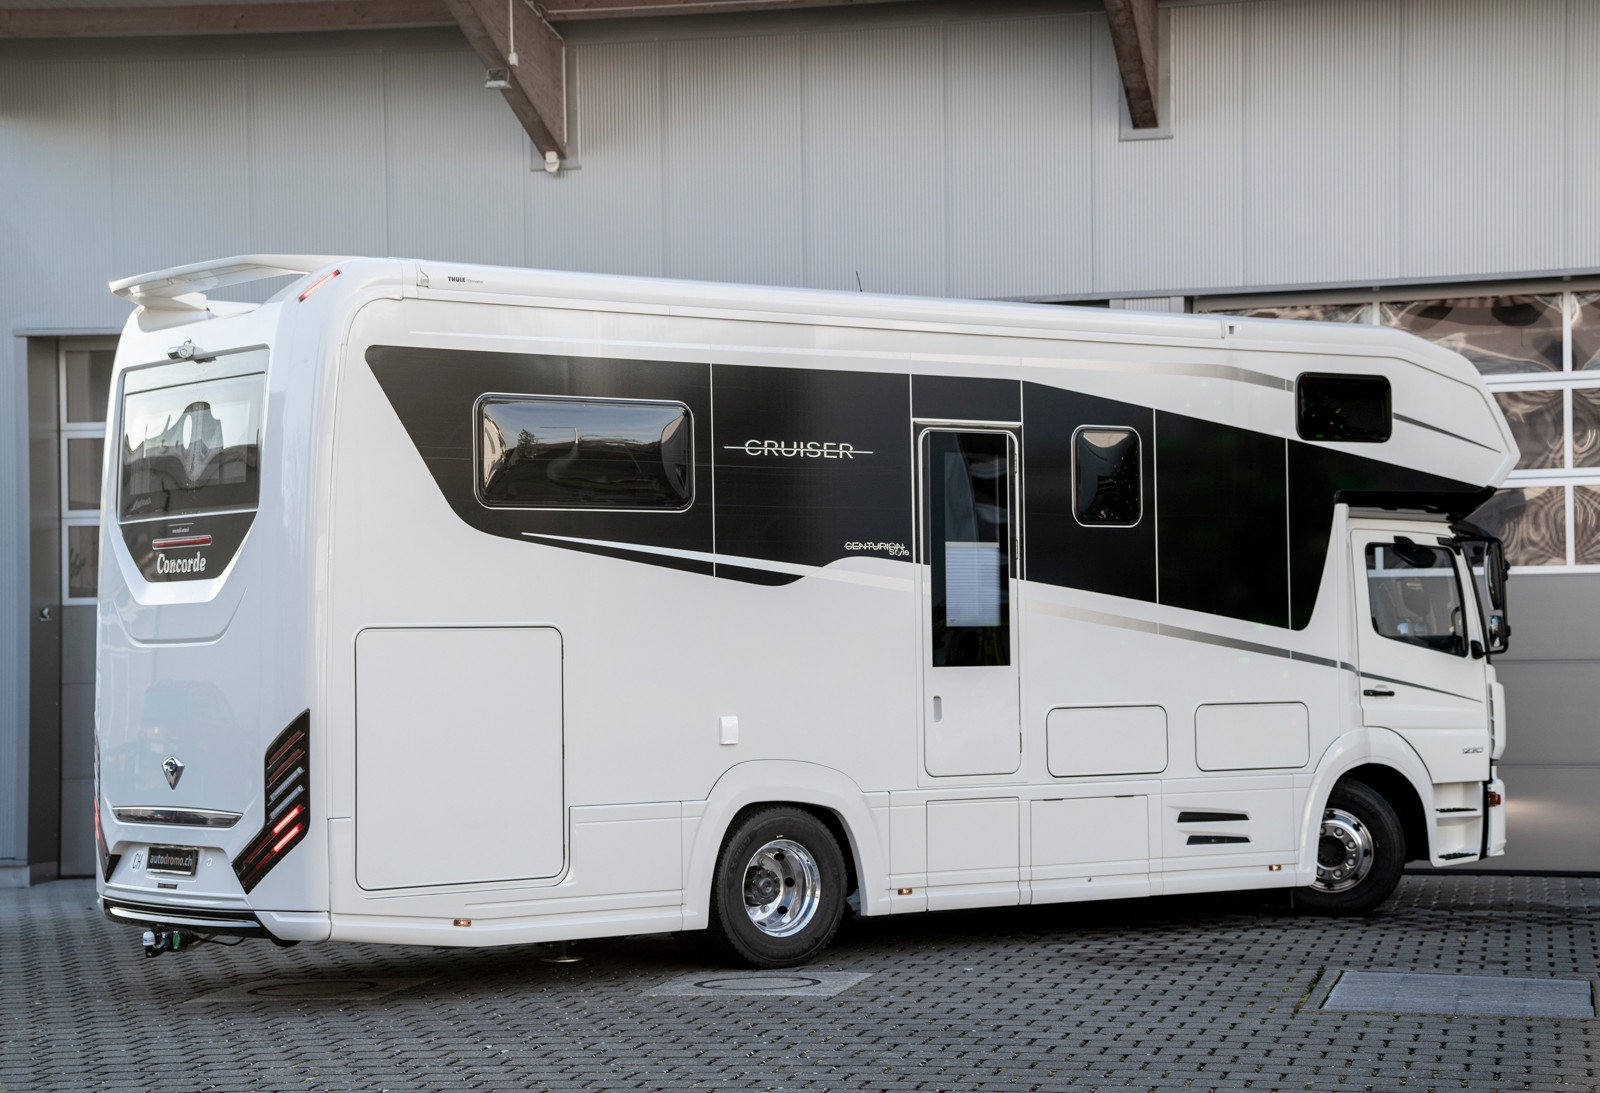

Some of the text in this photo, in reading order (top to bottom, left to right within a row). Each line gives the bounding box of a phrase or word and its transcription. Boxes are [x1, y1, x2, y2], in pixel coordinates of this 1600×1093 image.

[744, 439, 854, 460] CRUISER
[844, 541, 905, 551] CENTURION
[888, 547, 910, 557] Style
[156, 550, 207, 574] Concorde
[149, 853, 193, 867] autodromo.ch
